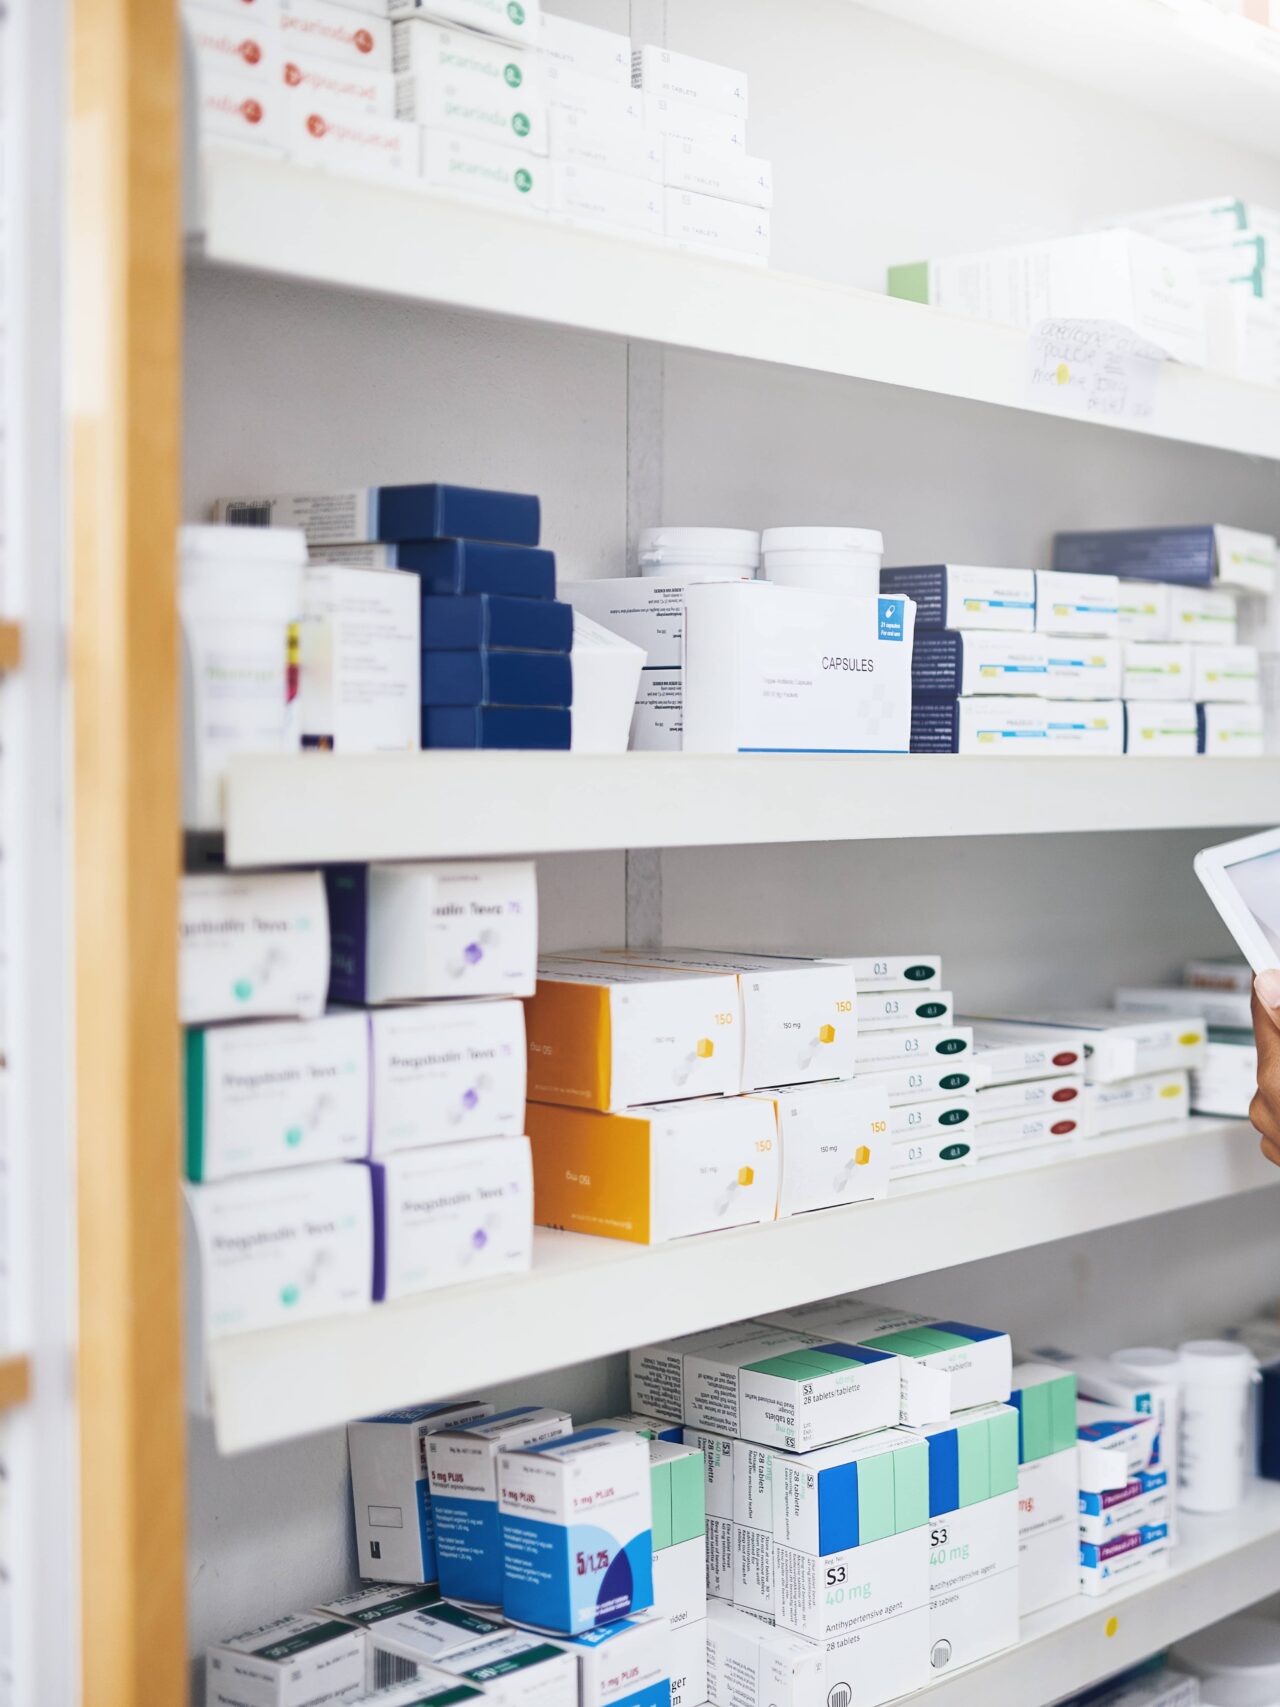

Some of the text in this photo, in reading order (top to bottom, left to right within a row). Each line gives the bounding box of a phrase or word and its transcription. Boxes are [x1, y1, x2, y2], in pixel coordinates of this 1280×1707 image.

[822, 656, 874, 673] CAPSULES
[874, 963, 888, 975] 0.3
[836, 1001, 852, 1013] 150
[885, 1001, 899, 1014] 0.3
[714, 1013, 733, 1025] 150
[783, 1022, 792, 1030] 150
[905, 1039, 919, 1052] 0.3
[909, 1075, 923, 1088] 0.3
[908, 1112, 922, 1125] 0.3
[871, 1121, 887, 1133] 150
[755, 1139, 772, 1152] 150
[821, 1145, 831, 1153] 150
[909, 1147, 923, 1160] 0.3
[803, 1384, 813, 1394] S3
[803, 1396, 812, 1405] 28
[764, 1411, 794, 1426] 28 tablets
[758, 1451, 765, 1464] 28
[431, 1469, 464, 1483] 5 mg PLUS
[501, 1486, 536, 1504] 5 mg PLUS
[573, 1486, 614, 1507] 5 mg PLUS
[930, 1528, 948, 1547] S3
[929, 1543, 969, 1566] 40 mg
[826, 1566, 846, 1586] S3
[826, 1582, 872, 1606] 40 mg
[825, 1602, 903, 1634] Antihypertensive agent
[826, 1634, 861, 1652] 28 tablets
[608, 1677, 619, 1686] mg
[621, 1667, 640, 1681] PLUS
